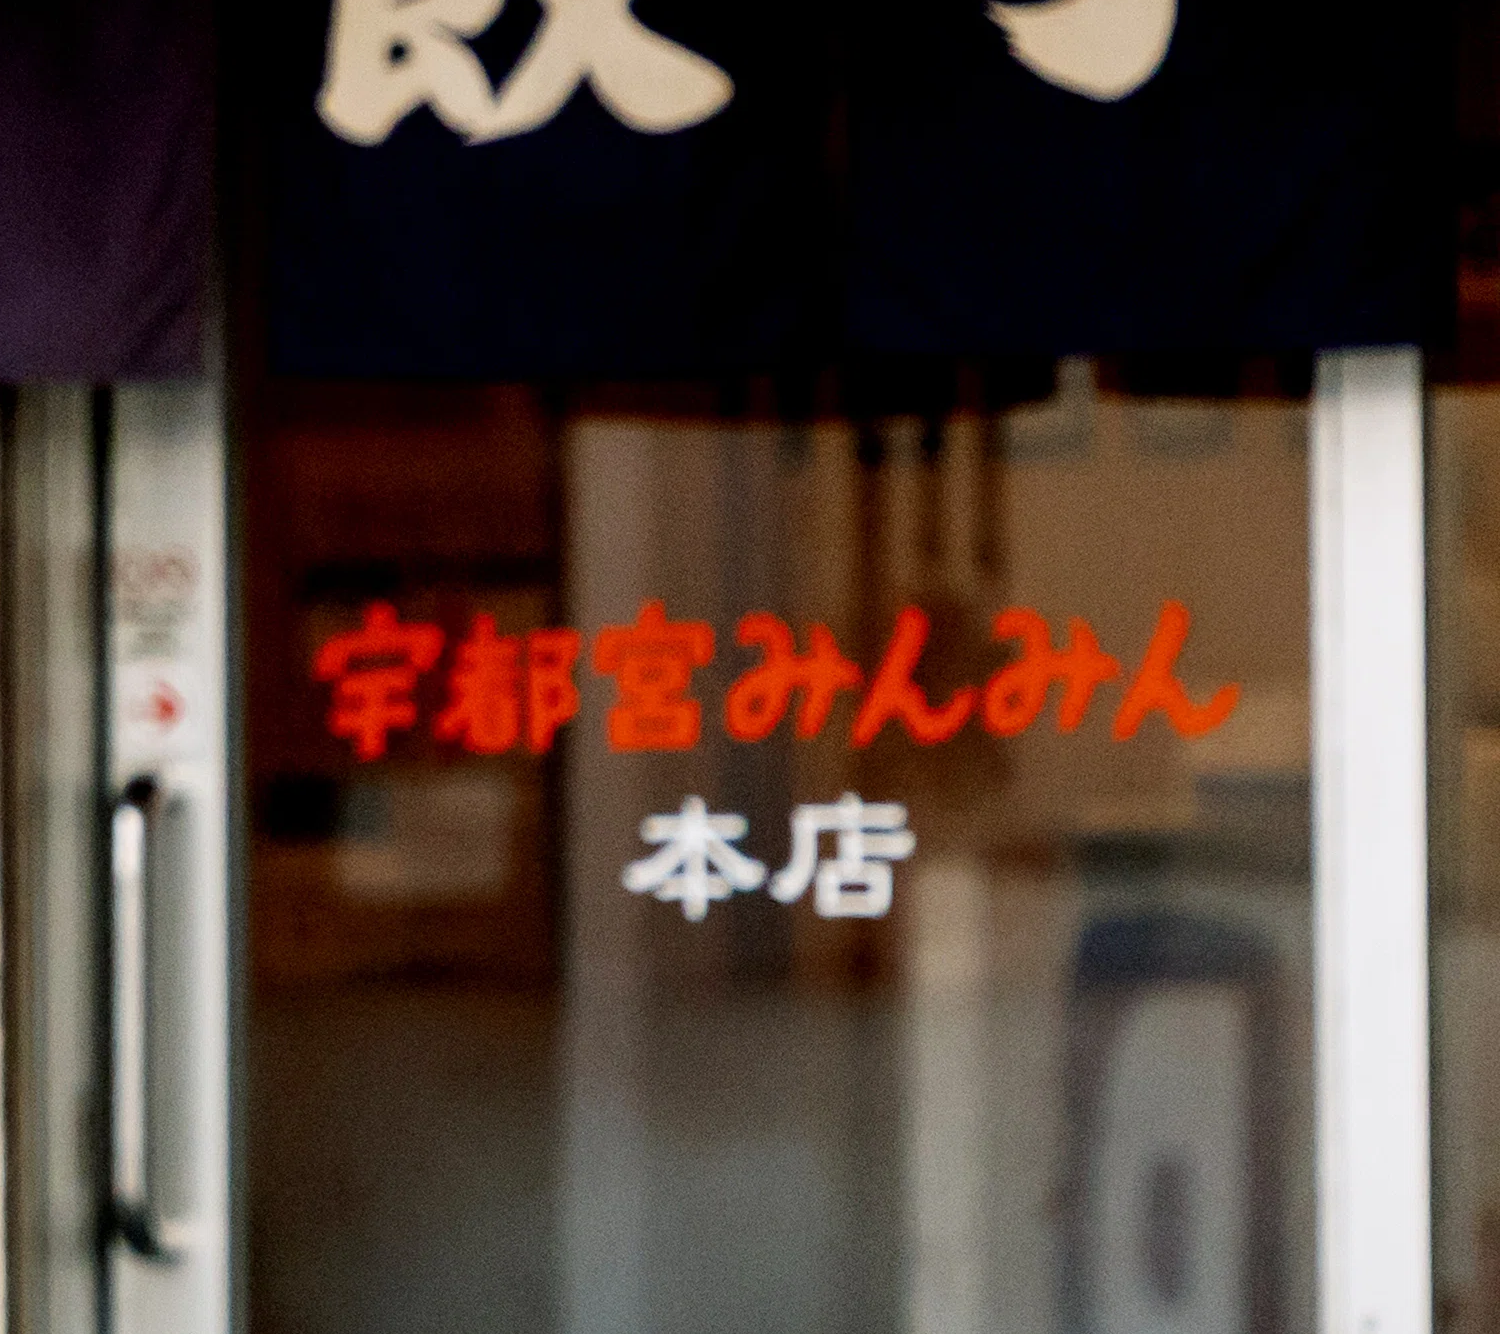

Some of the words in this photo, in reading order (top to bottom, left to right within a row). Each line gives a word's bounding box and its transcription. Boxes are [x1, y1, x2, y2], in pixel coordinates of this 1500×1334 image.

[312, 597, 1242, 761] 宇都宮みんみん
[622, 794, 916, 921] 本店
